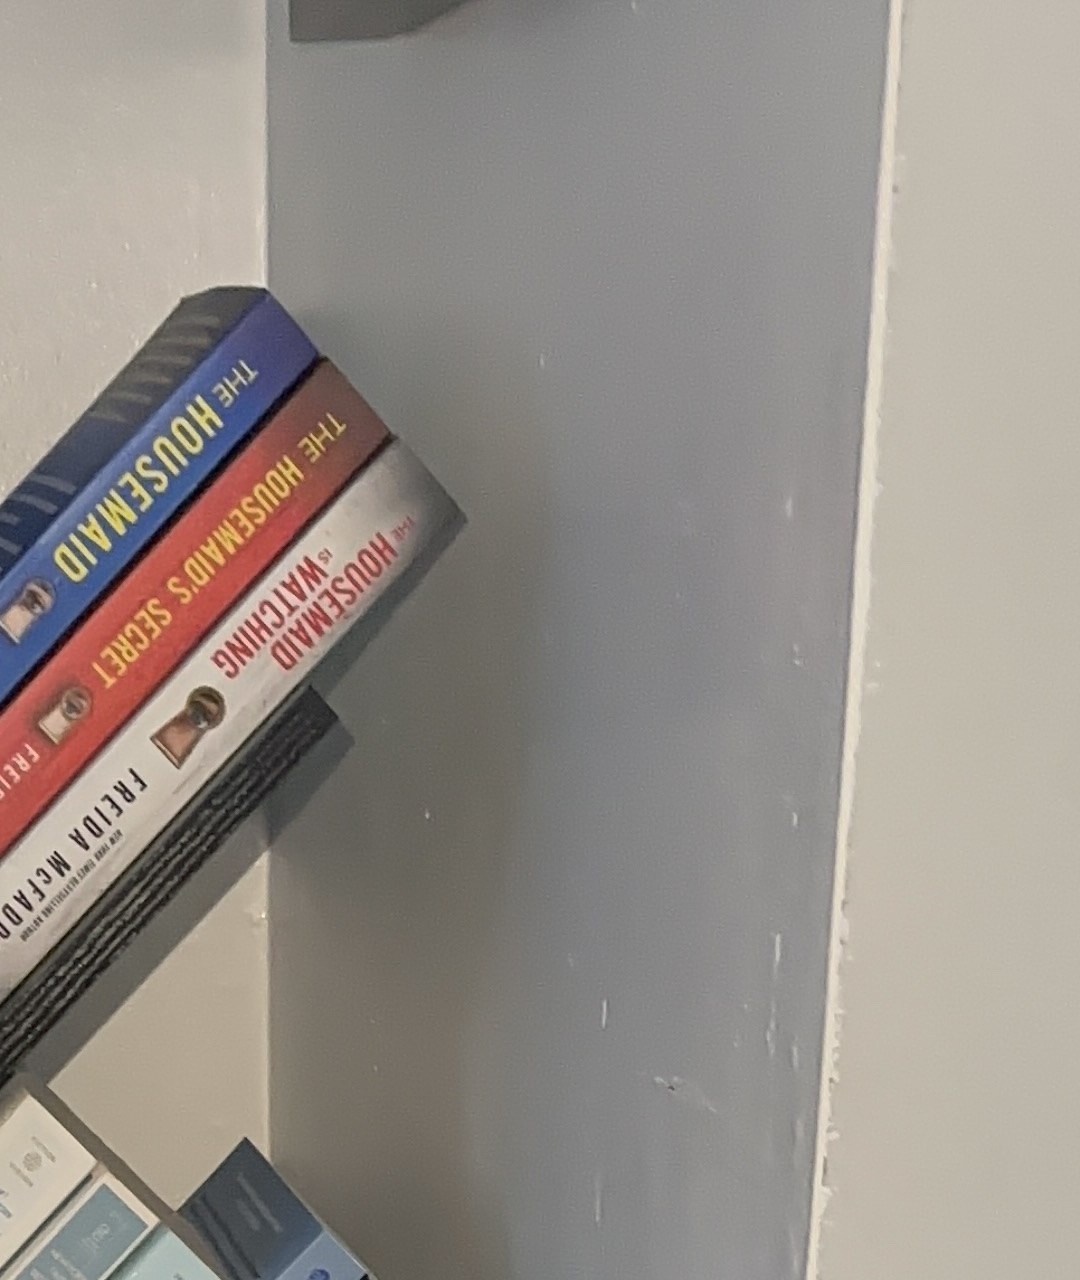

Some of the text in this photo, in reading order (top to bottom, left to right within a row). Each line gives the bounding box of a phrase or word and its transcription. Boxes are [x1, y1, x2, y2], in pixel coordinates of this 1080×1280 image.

[53, 359, 259, 583] THE HOUSEMAID
[91, 412, 347, 689] THE HOUSEMAID'S SECRET
[210, 547, 333, 679] IS WATCHING
[270, 516, 417, 671] THE HOUSEMAID
[68, 767, 148, 851] FREIDA
